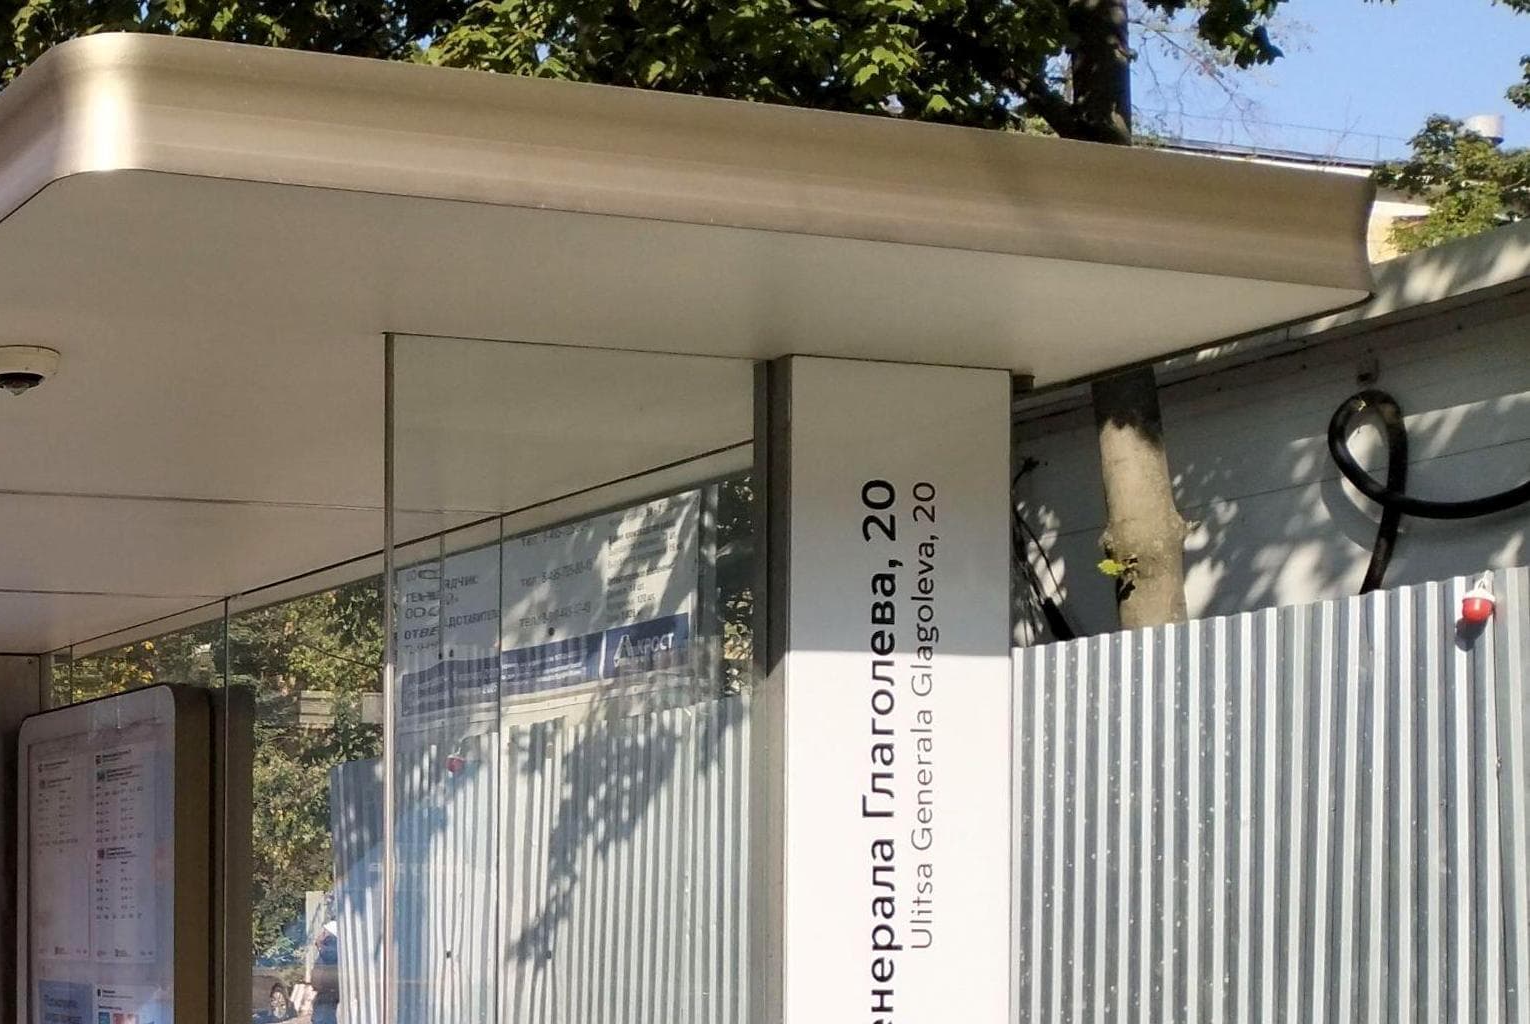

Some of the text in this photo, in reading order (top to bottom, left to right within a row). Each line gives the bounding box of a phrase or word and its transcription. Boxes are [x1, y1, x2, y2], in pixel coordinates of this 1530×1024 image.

[861, 479, 897, 543] 20
[861, 559, 903, 819] Глаголева,
[910, 482, 940, 949] Ulitsa Generala Glagoleva, 20
